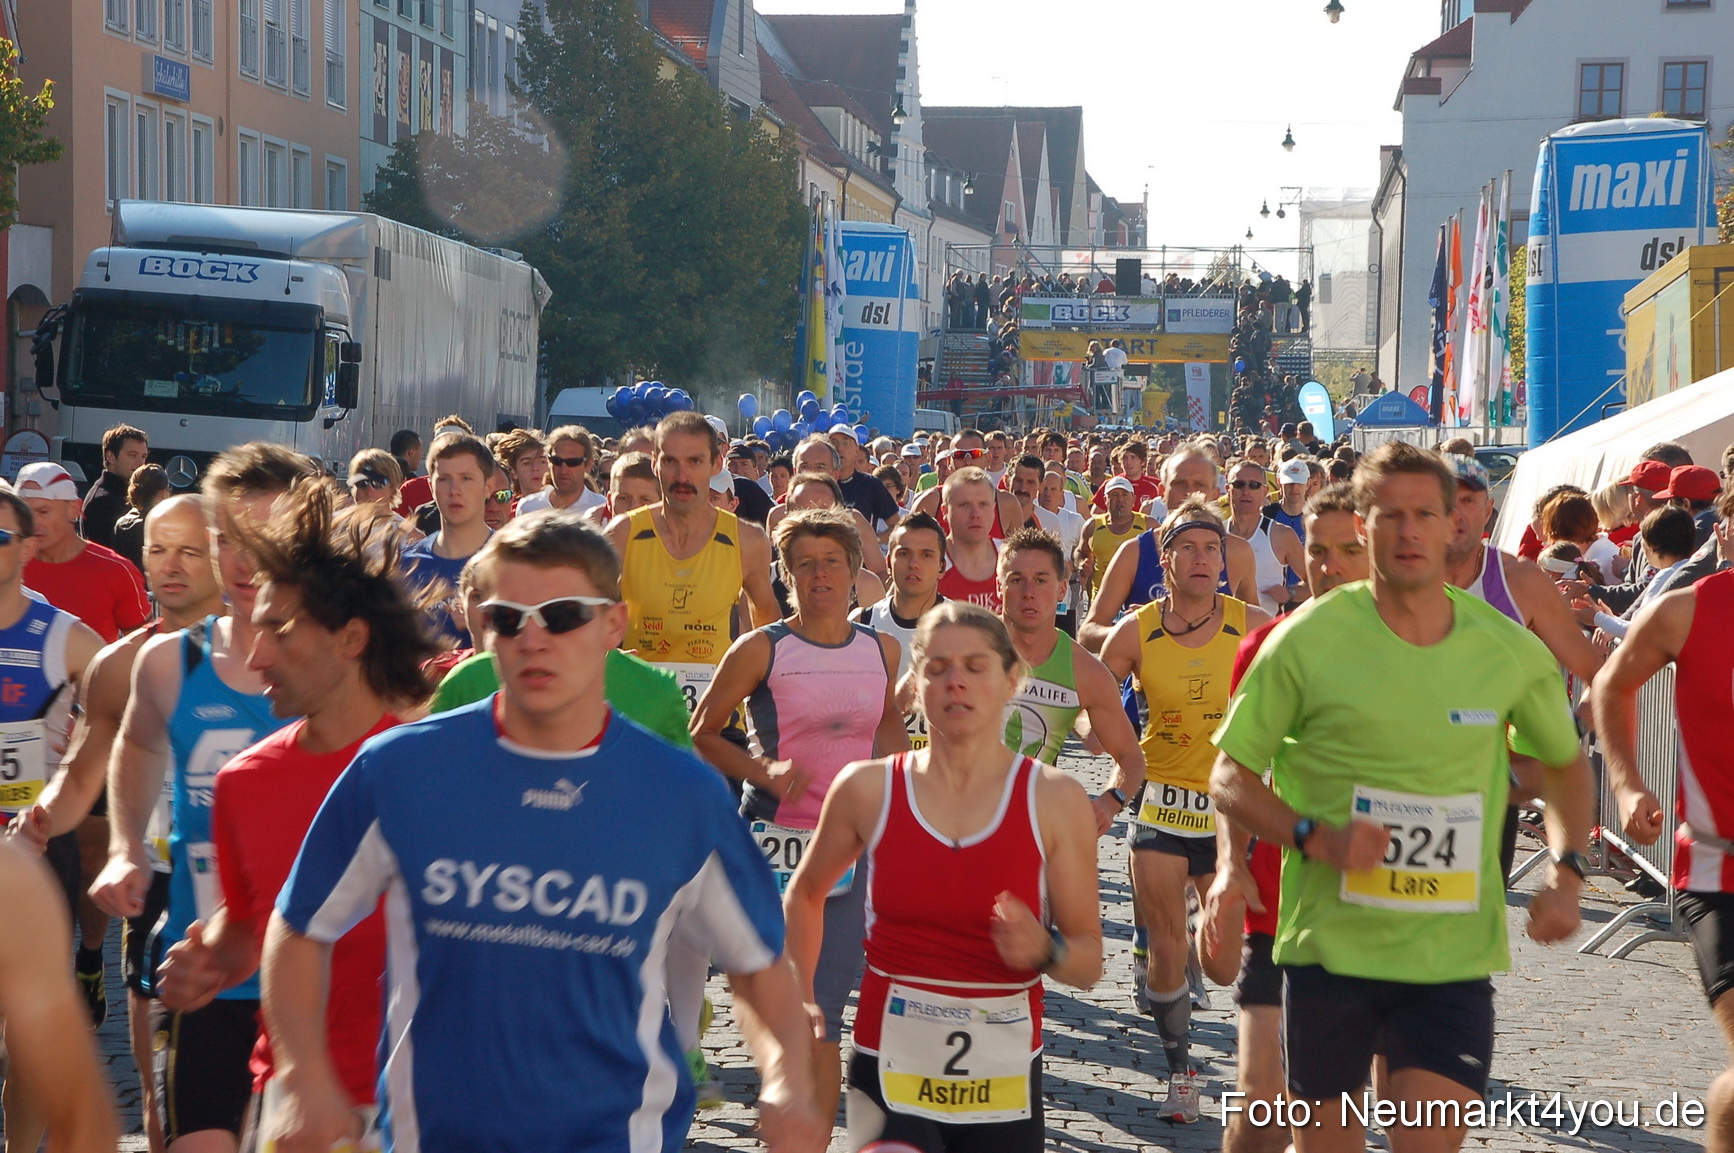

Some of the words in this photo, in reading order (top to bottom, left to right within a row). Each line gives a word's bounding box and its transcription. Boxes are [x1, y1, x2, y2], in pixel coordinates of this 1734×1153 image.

[1569, 148, 1688, 211] maxi
[139, 255, 260, 283] BOCK
[844, 245, 897, 282] axi
[861, 301, 891, 325] dsl
[1052, 304, 1130, 321] BOCK
[1182, 308, 1230, 318] PFLEIDERER
[643, 622, 664, 631] Seidl
[1161, 784, 1209, 811] 618
[1156, 808, 1210, 829] Helmut
[761, 836, 814, 870] 20
[1382, 822, 1458, 868] 524
[421, 858, 648, 927] SYSCAD
[1388, 871, 1440, 896] Lars
[424, 917, 638, 958] www.metallbau-cad.de
[943, 1031, 972, 1076] 2
[918, 1078, 990, 1105] Astrid
